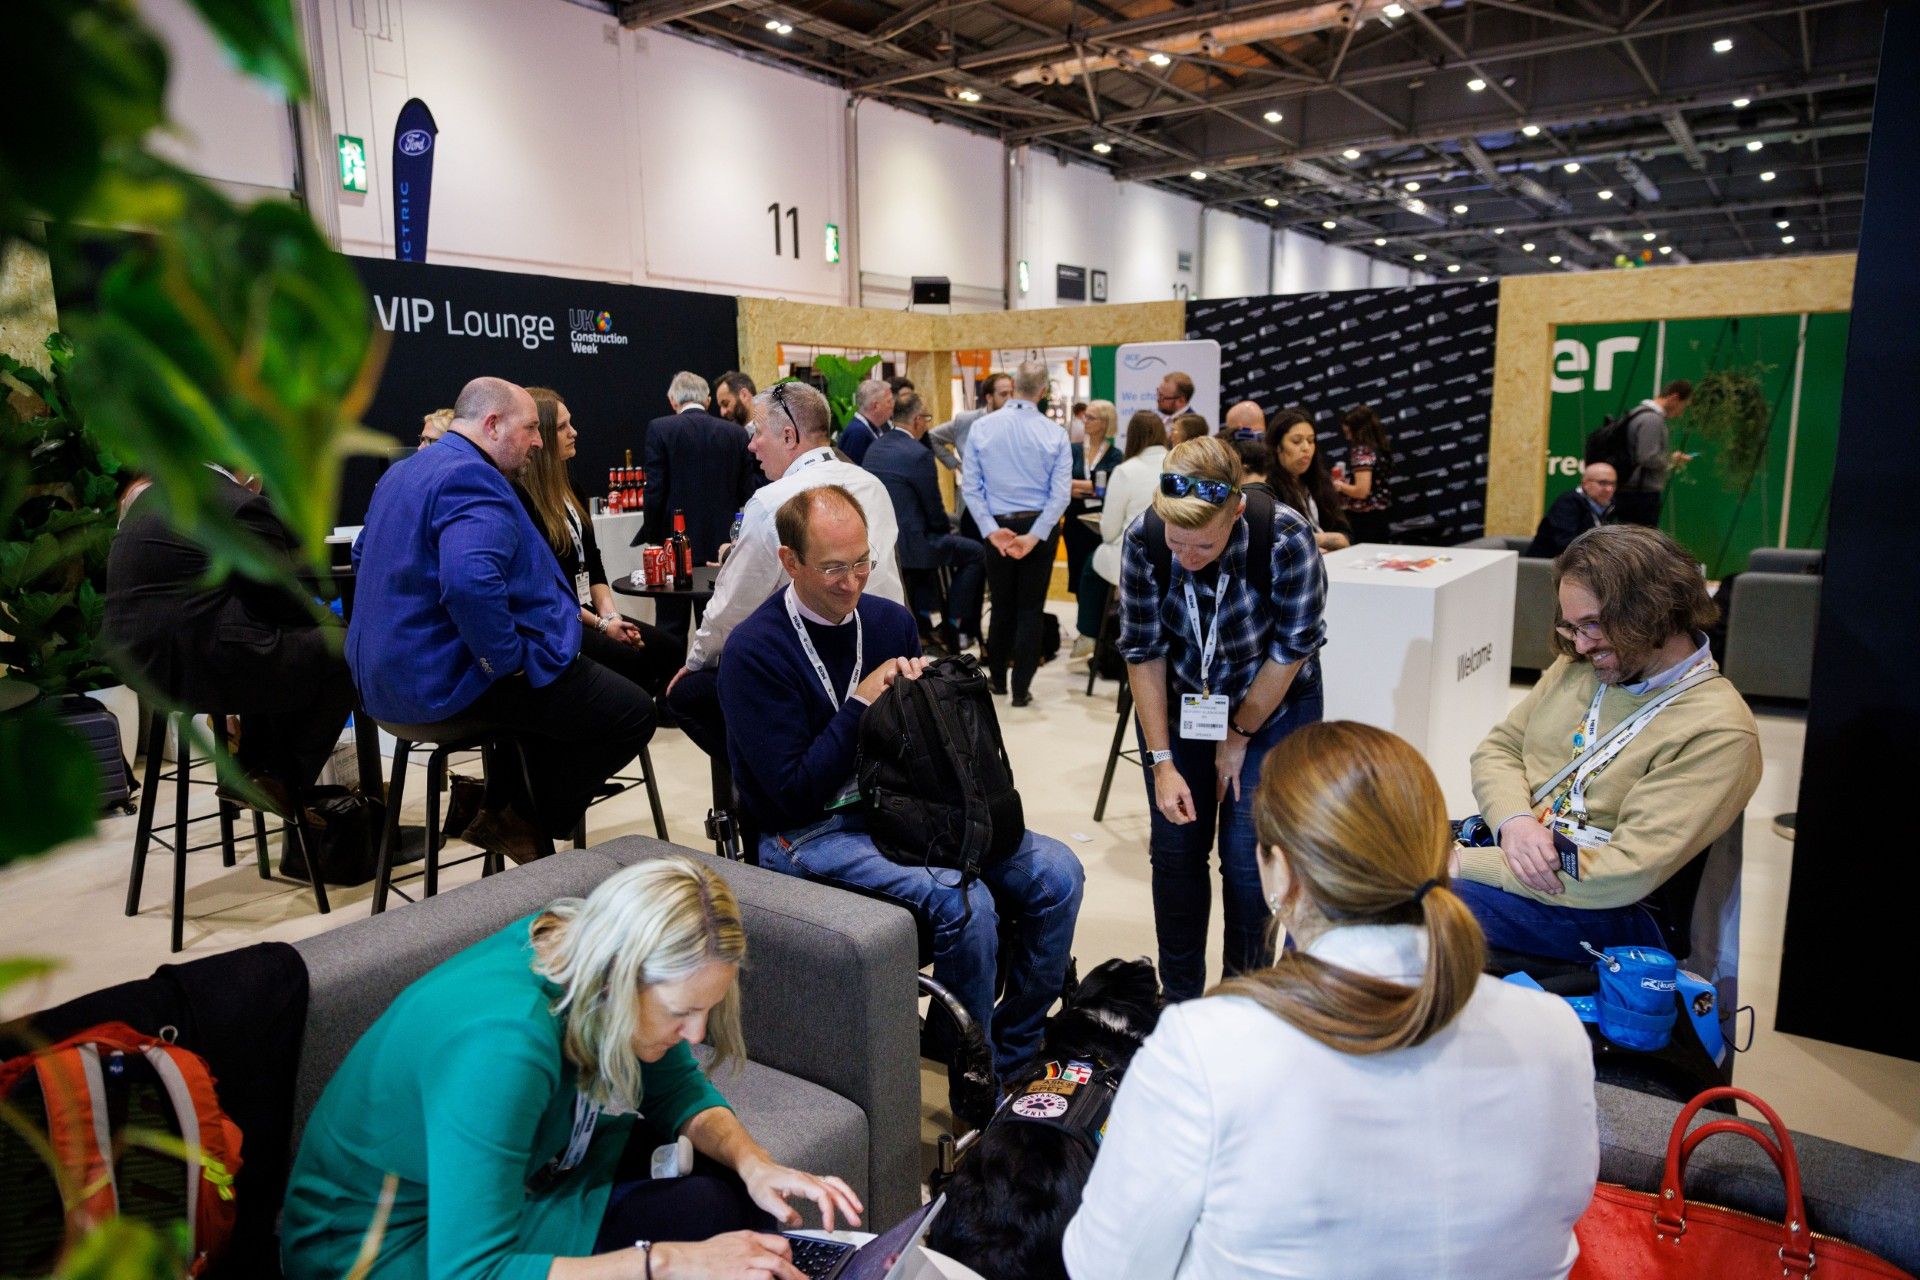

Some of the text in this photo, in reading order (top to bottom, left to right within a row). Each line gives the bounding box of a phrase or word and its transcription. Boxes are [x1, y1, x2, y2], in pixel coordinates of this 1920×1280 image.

[404, 133, 426, 152] Ford
[767, 202, 800, 260] 11
[373, 294, 556, 350] VIP Lounge
[568, 307, 596, 332] UK
[570, 330, 628, 345] Construction
[571, 342, 599, 355] Week
[1456, 642, 1492, 682] Welcome
